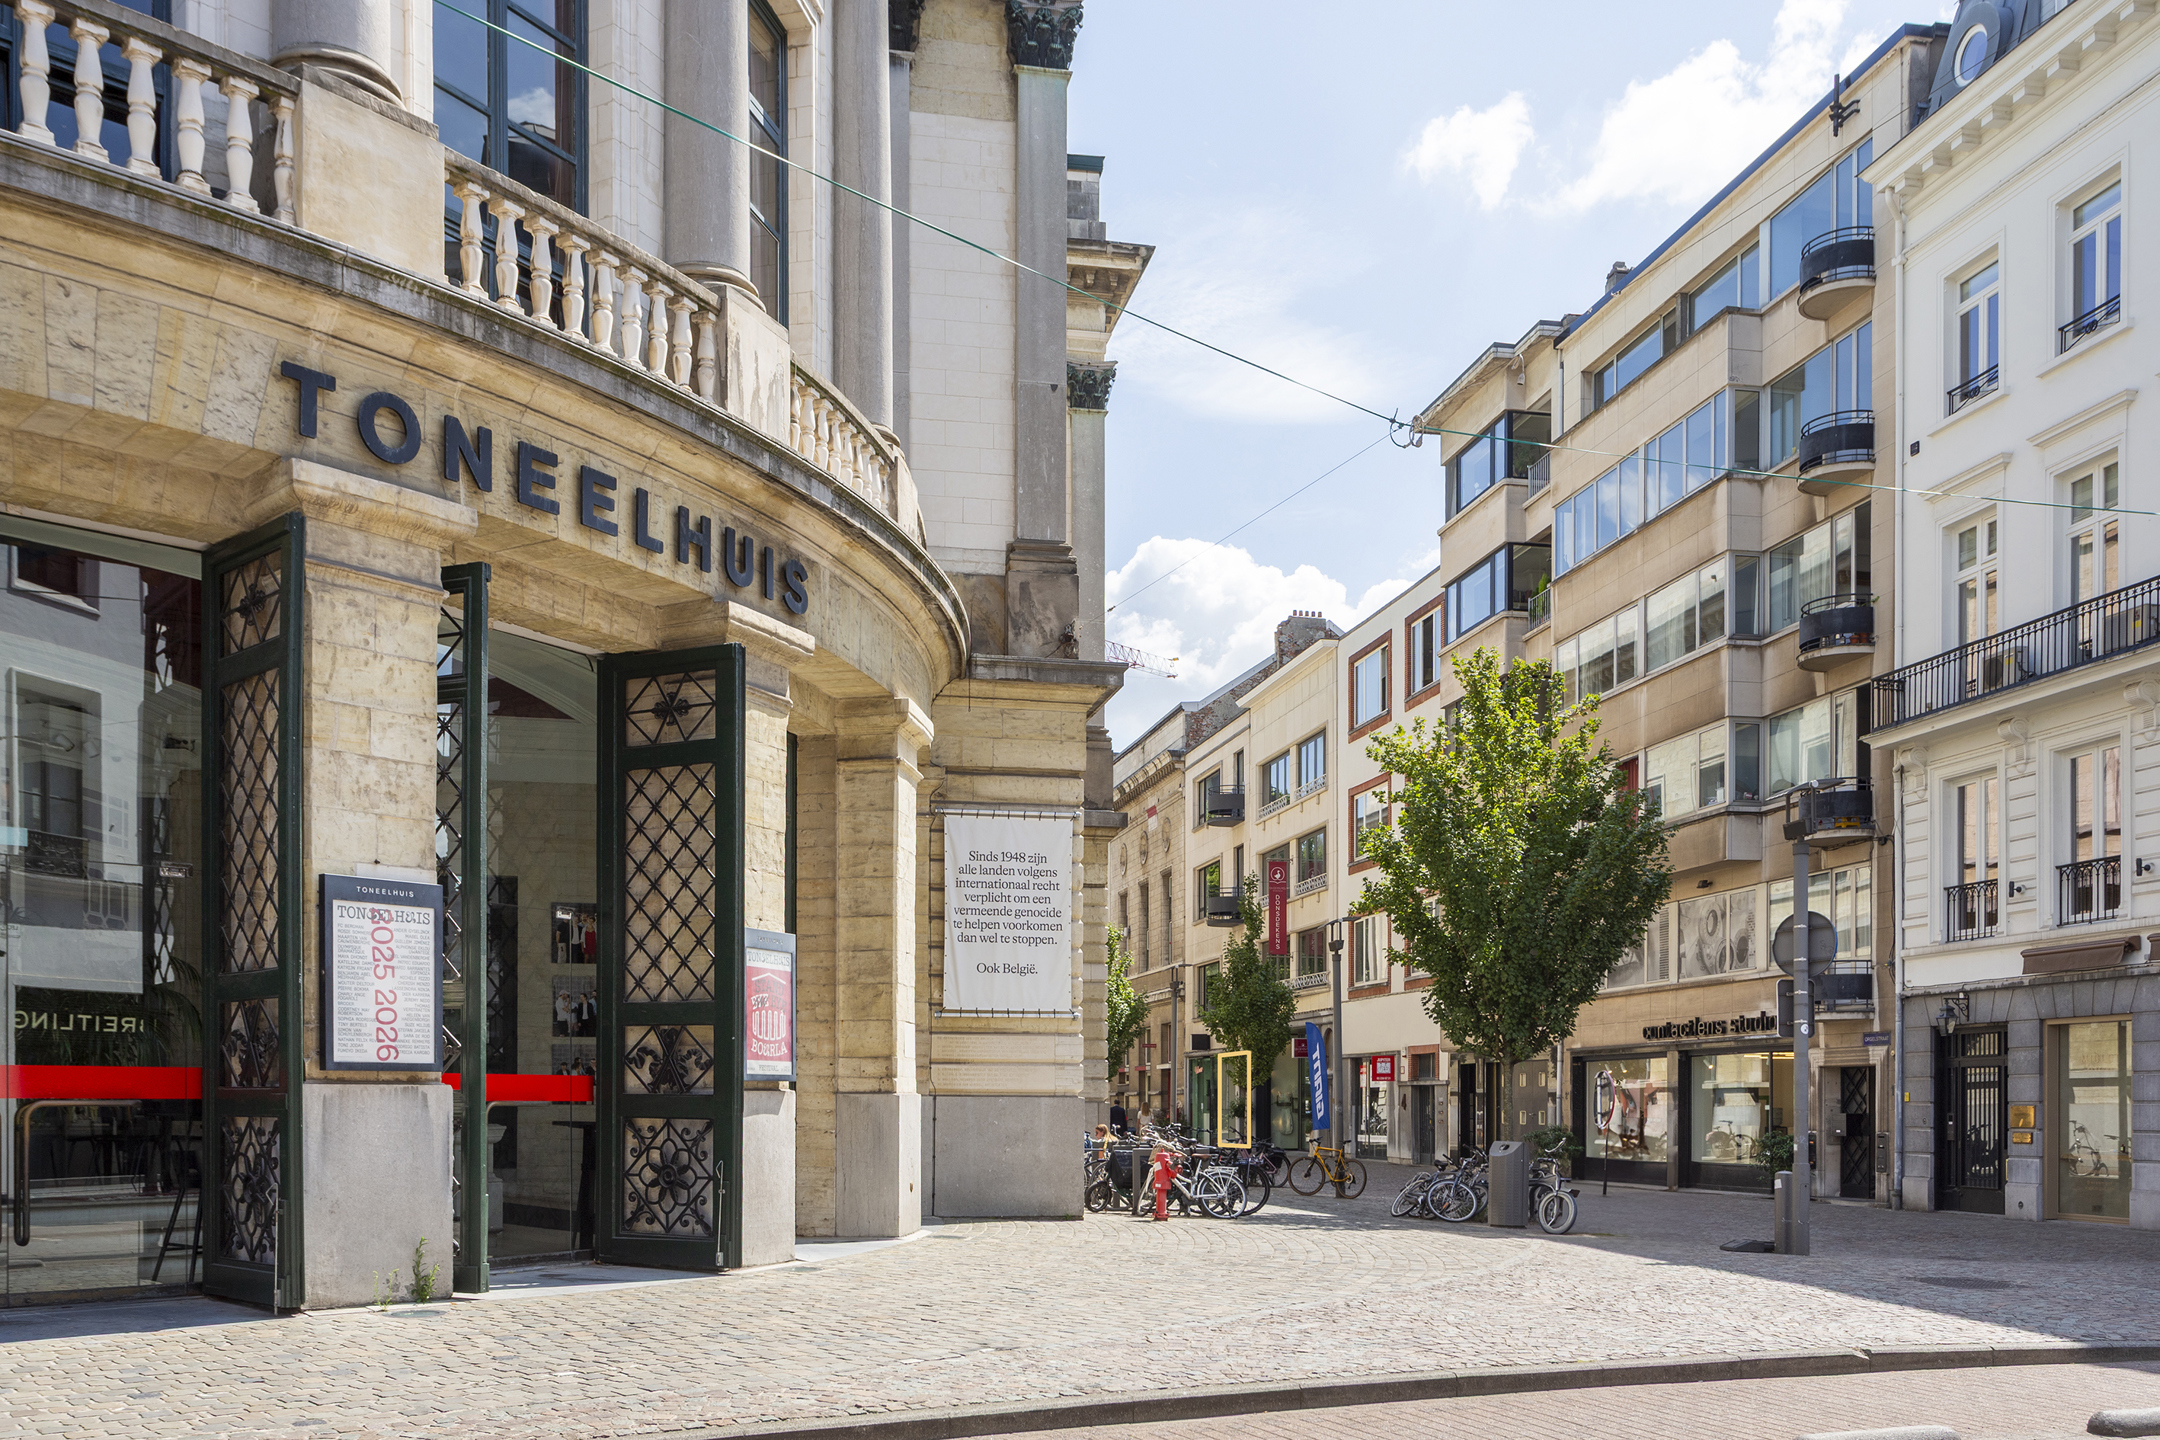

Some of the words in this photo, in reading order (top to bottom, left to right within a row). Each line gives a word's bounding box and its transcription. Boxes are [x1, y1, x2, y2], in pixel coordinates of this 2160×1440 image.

[281, 360, 810, 615] TONEELHUIS
[968, 850, 999, 862] Sinds
[1000, 851, 1026, 864] 1948
[1027, 852, 1048, 867] zijn
[958, 864, 977, 875] alle
[978, 864, 1016, 876] landen
[1017, 865, 1058, 880] volgens
[356, 885, 415, 898] TONEELHUIS
[955, 877, 1030, 890] internationaal
[1032, 879, 1061, 891] recht
[964, 891, 1012, 905] verplicht
[1013, 895, 1031, 904] om
[1032, 895, 1051, 905] een
[953, 905, 1013, 917] vermeende
[1014, 906, 1062, 919] genocide
[953, 920, 963, 929] te
[964, 919, 1001, 933] helpen
[1002, 920, 1064, 932] voorkomen
[371, 907, 395, 980] 2025
[957, 932, 977, 943] dan
[979, 933, 998, 944] wel
[1000, 935, 1011, 944] te
[1012, 935, 1058, 947] stoppen.
[976, 962, 1000, 974] Ook
[1002, 962, 1038, 977] België.
[754, 979, 784, 997] STAND
[375, 989, 399, 1061] 2026
[1730, 1011, 1777, 1033] studio
[1312, 1042, 1325, 1120] GIANT
